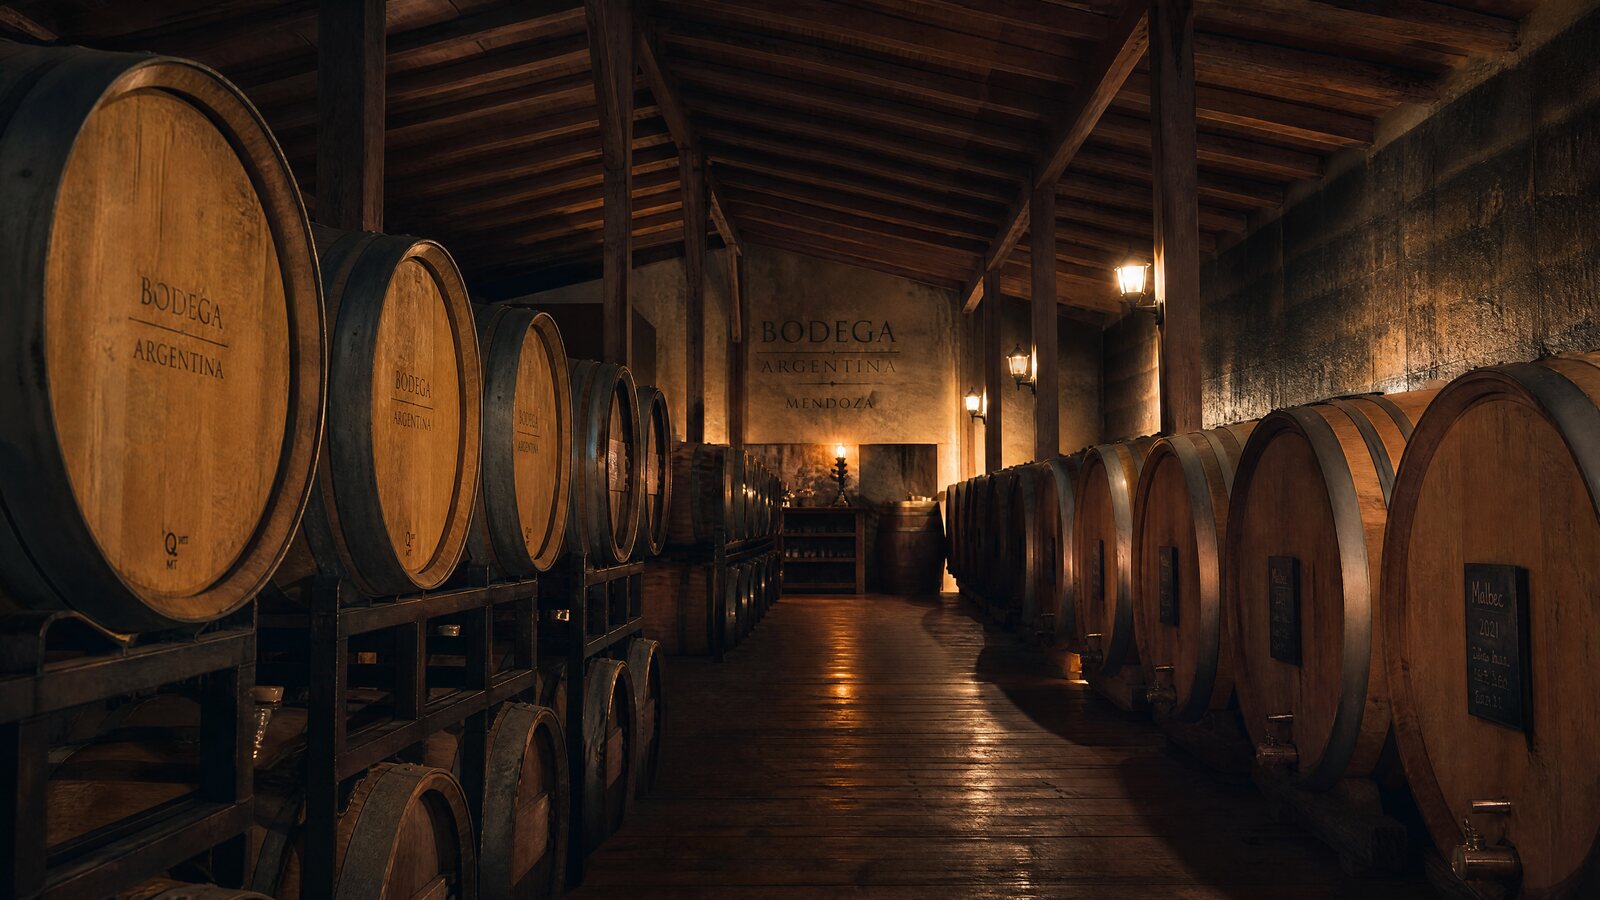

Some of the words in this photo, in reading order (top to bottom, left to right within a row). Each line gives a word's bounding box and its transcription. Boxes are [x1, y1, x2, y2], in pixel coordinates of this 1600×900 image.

[141, 276, 223, 329] BODEGA
[761, 320, 896, 343] BODEGA
[133, 338, 224, 379] ARGENTINA
[761, 359, 896, 373] ARGENTINA
[395, 370, 431, 398] BODEGA
[785, 397, 873, 409] MENDOZA
[393, 411, 431, 431] ARGENTINA
[1471, 581, 1504, 608] Malbec
[1479, 618, 1499, 639] 2021
